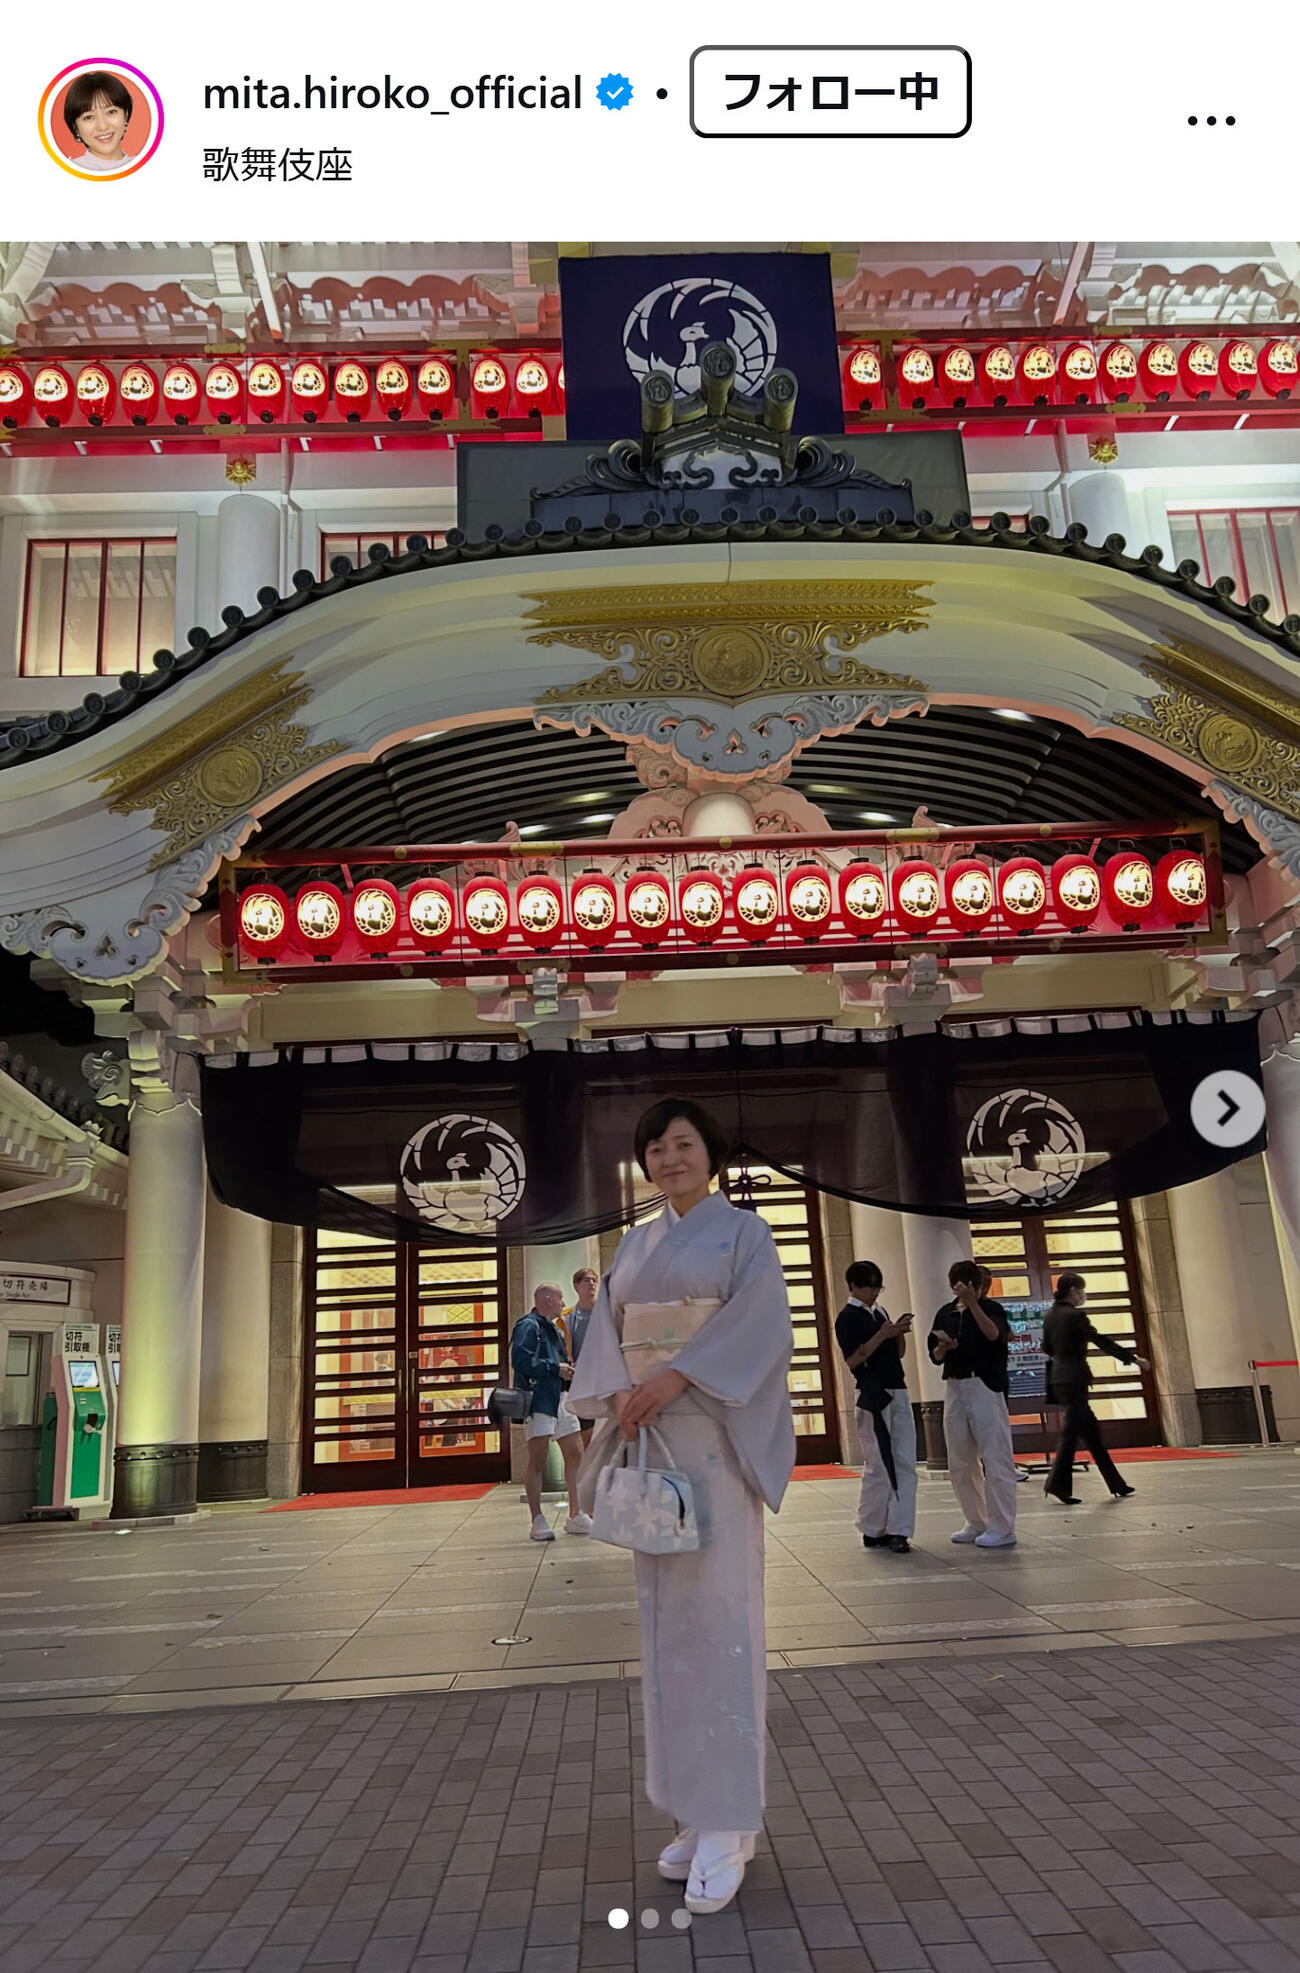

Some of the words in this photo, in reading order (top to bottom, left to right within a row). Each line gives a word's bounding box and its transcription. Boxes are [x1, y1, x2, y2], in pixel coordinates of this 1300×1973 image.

[65, 1331, 82, 1341] 切符
[65, 1342, 90, 1352] 引取機
